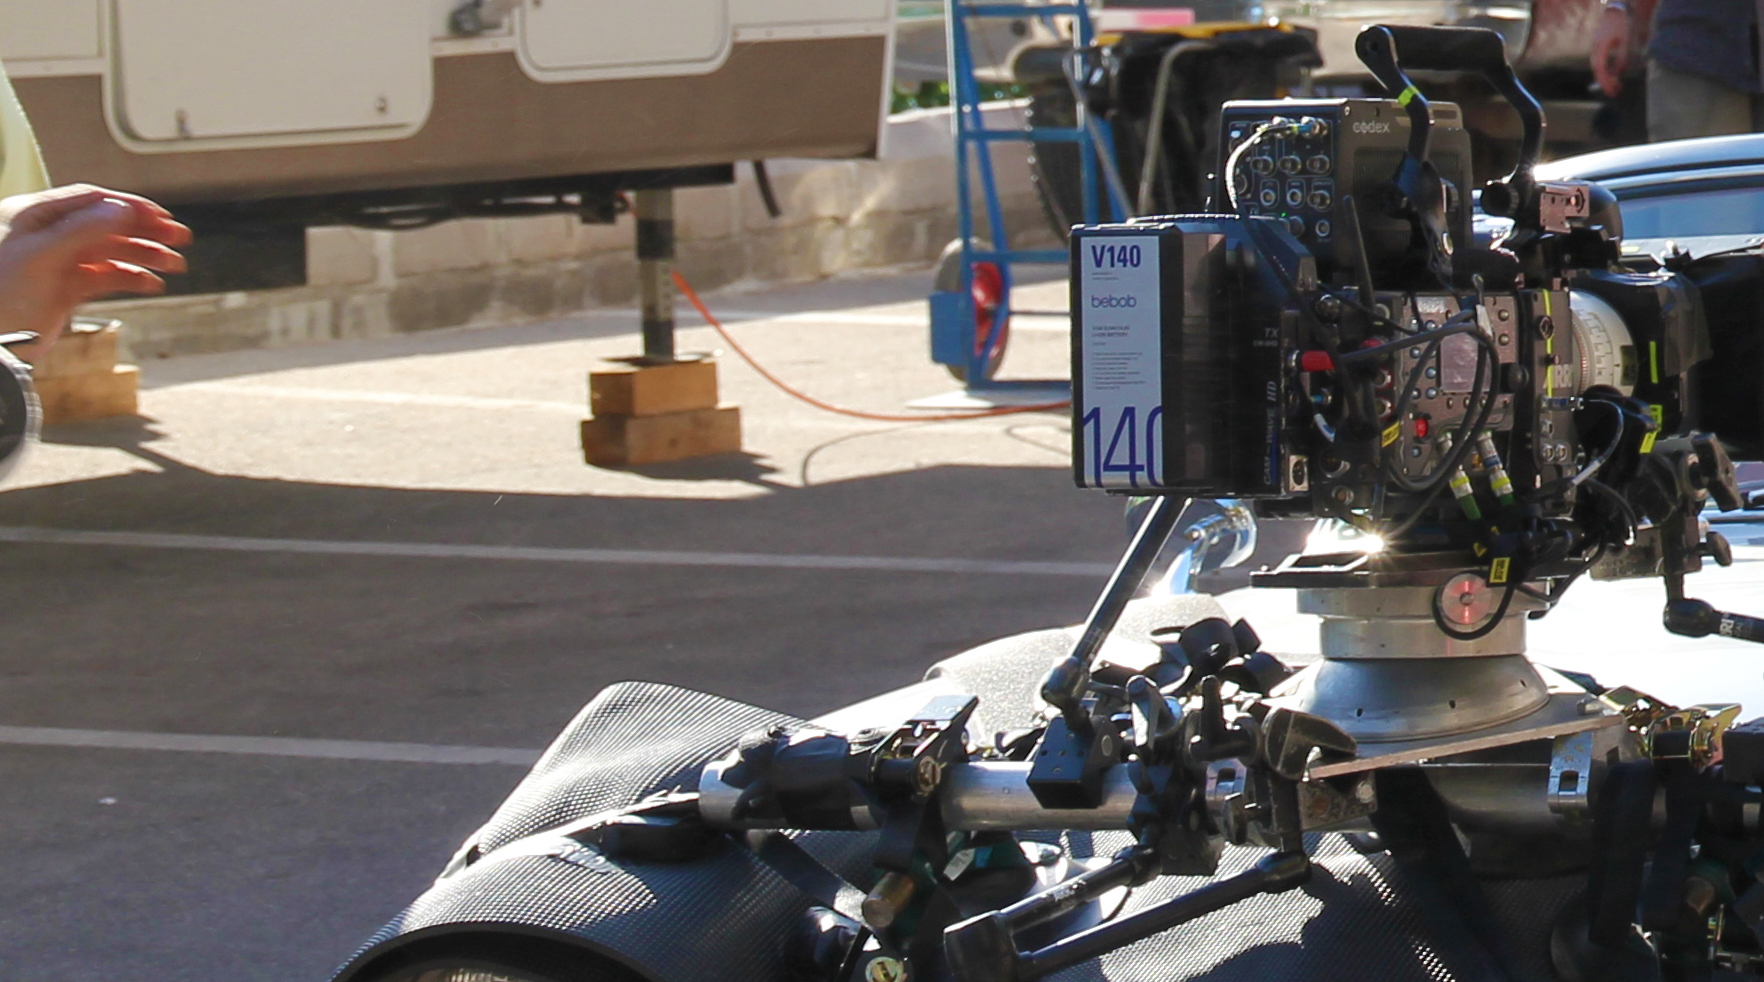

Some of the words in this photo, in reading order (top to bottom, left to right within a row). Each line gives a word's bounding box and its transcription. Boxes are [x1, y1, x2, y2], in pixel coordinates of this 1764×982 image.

[1353, 120, 1391, 133] codex
[1091, 245, 1142, 268] V140
[1091, 294, 1138, 308] bebob
